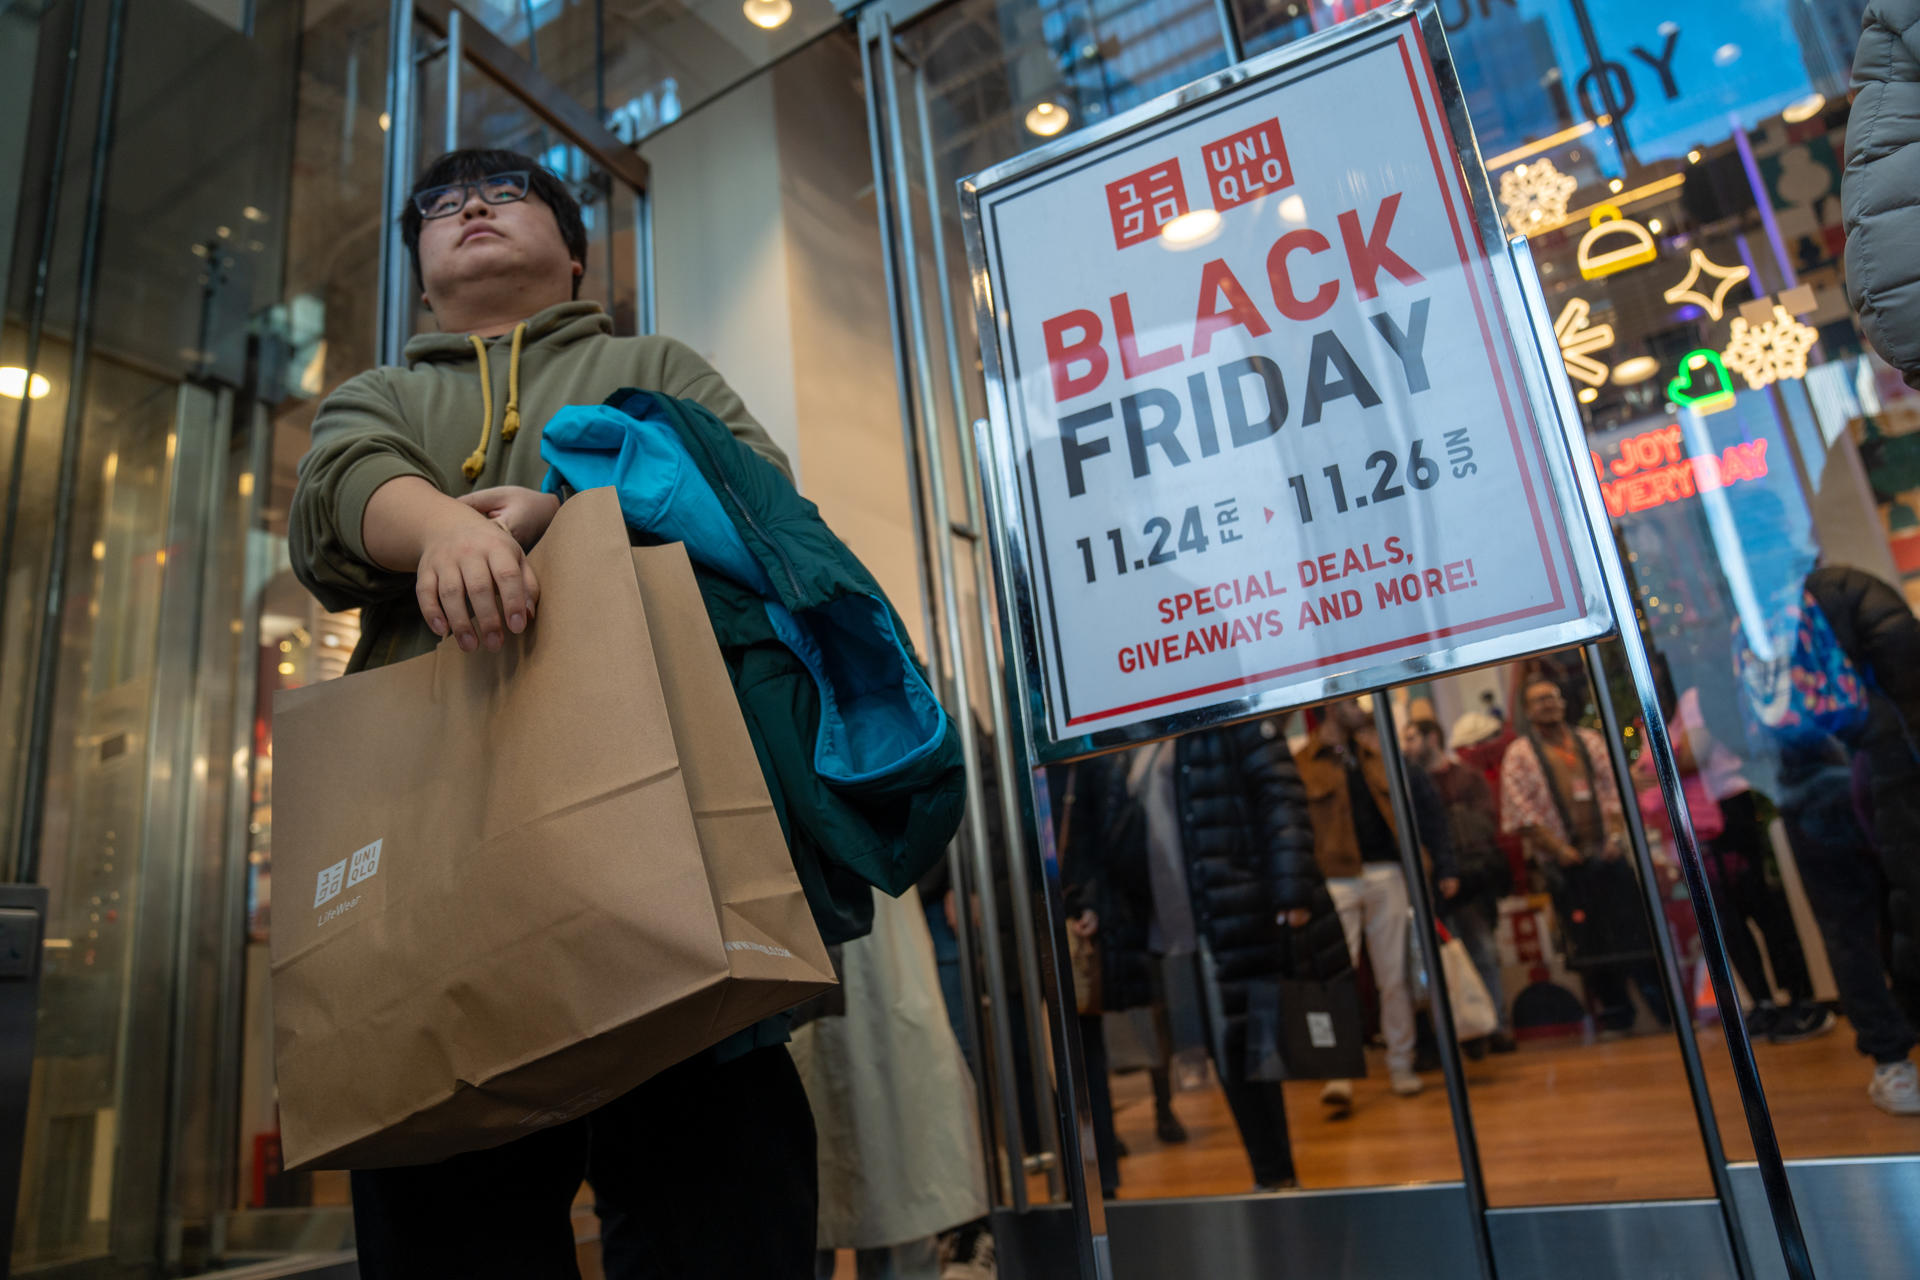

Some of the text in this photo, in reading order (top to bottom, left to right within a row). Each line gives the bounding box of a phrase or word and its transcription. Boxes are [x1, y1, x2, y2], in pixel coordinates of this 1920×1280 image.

[1211, 131, 1271, 172] UNI
[1218, 158, 1283, 202] QLO
[1042, 192, 1427, 404] BLACK
[1057, 297, 1431, 499] FRIDAY
[1599, 438, 1768, 517] VERYDAY
[1610, 424, 1682, 477] JOY
[1076, 426, 1478, 584] 11.24 FRI 11.26 SUN
[1118, 558, 1478, 675] GIVEAWAYS AND MORE!
[1158, 535, 1414, 625] SPECIAL DEALS,
[351, 860, 376, 882] QLO
[354, 846, 377, 867] UNI
